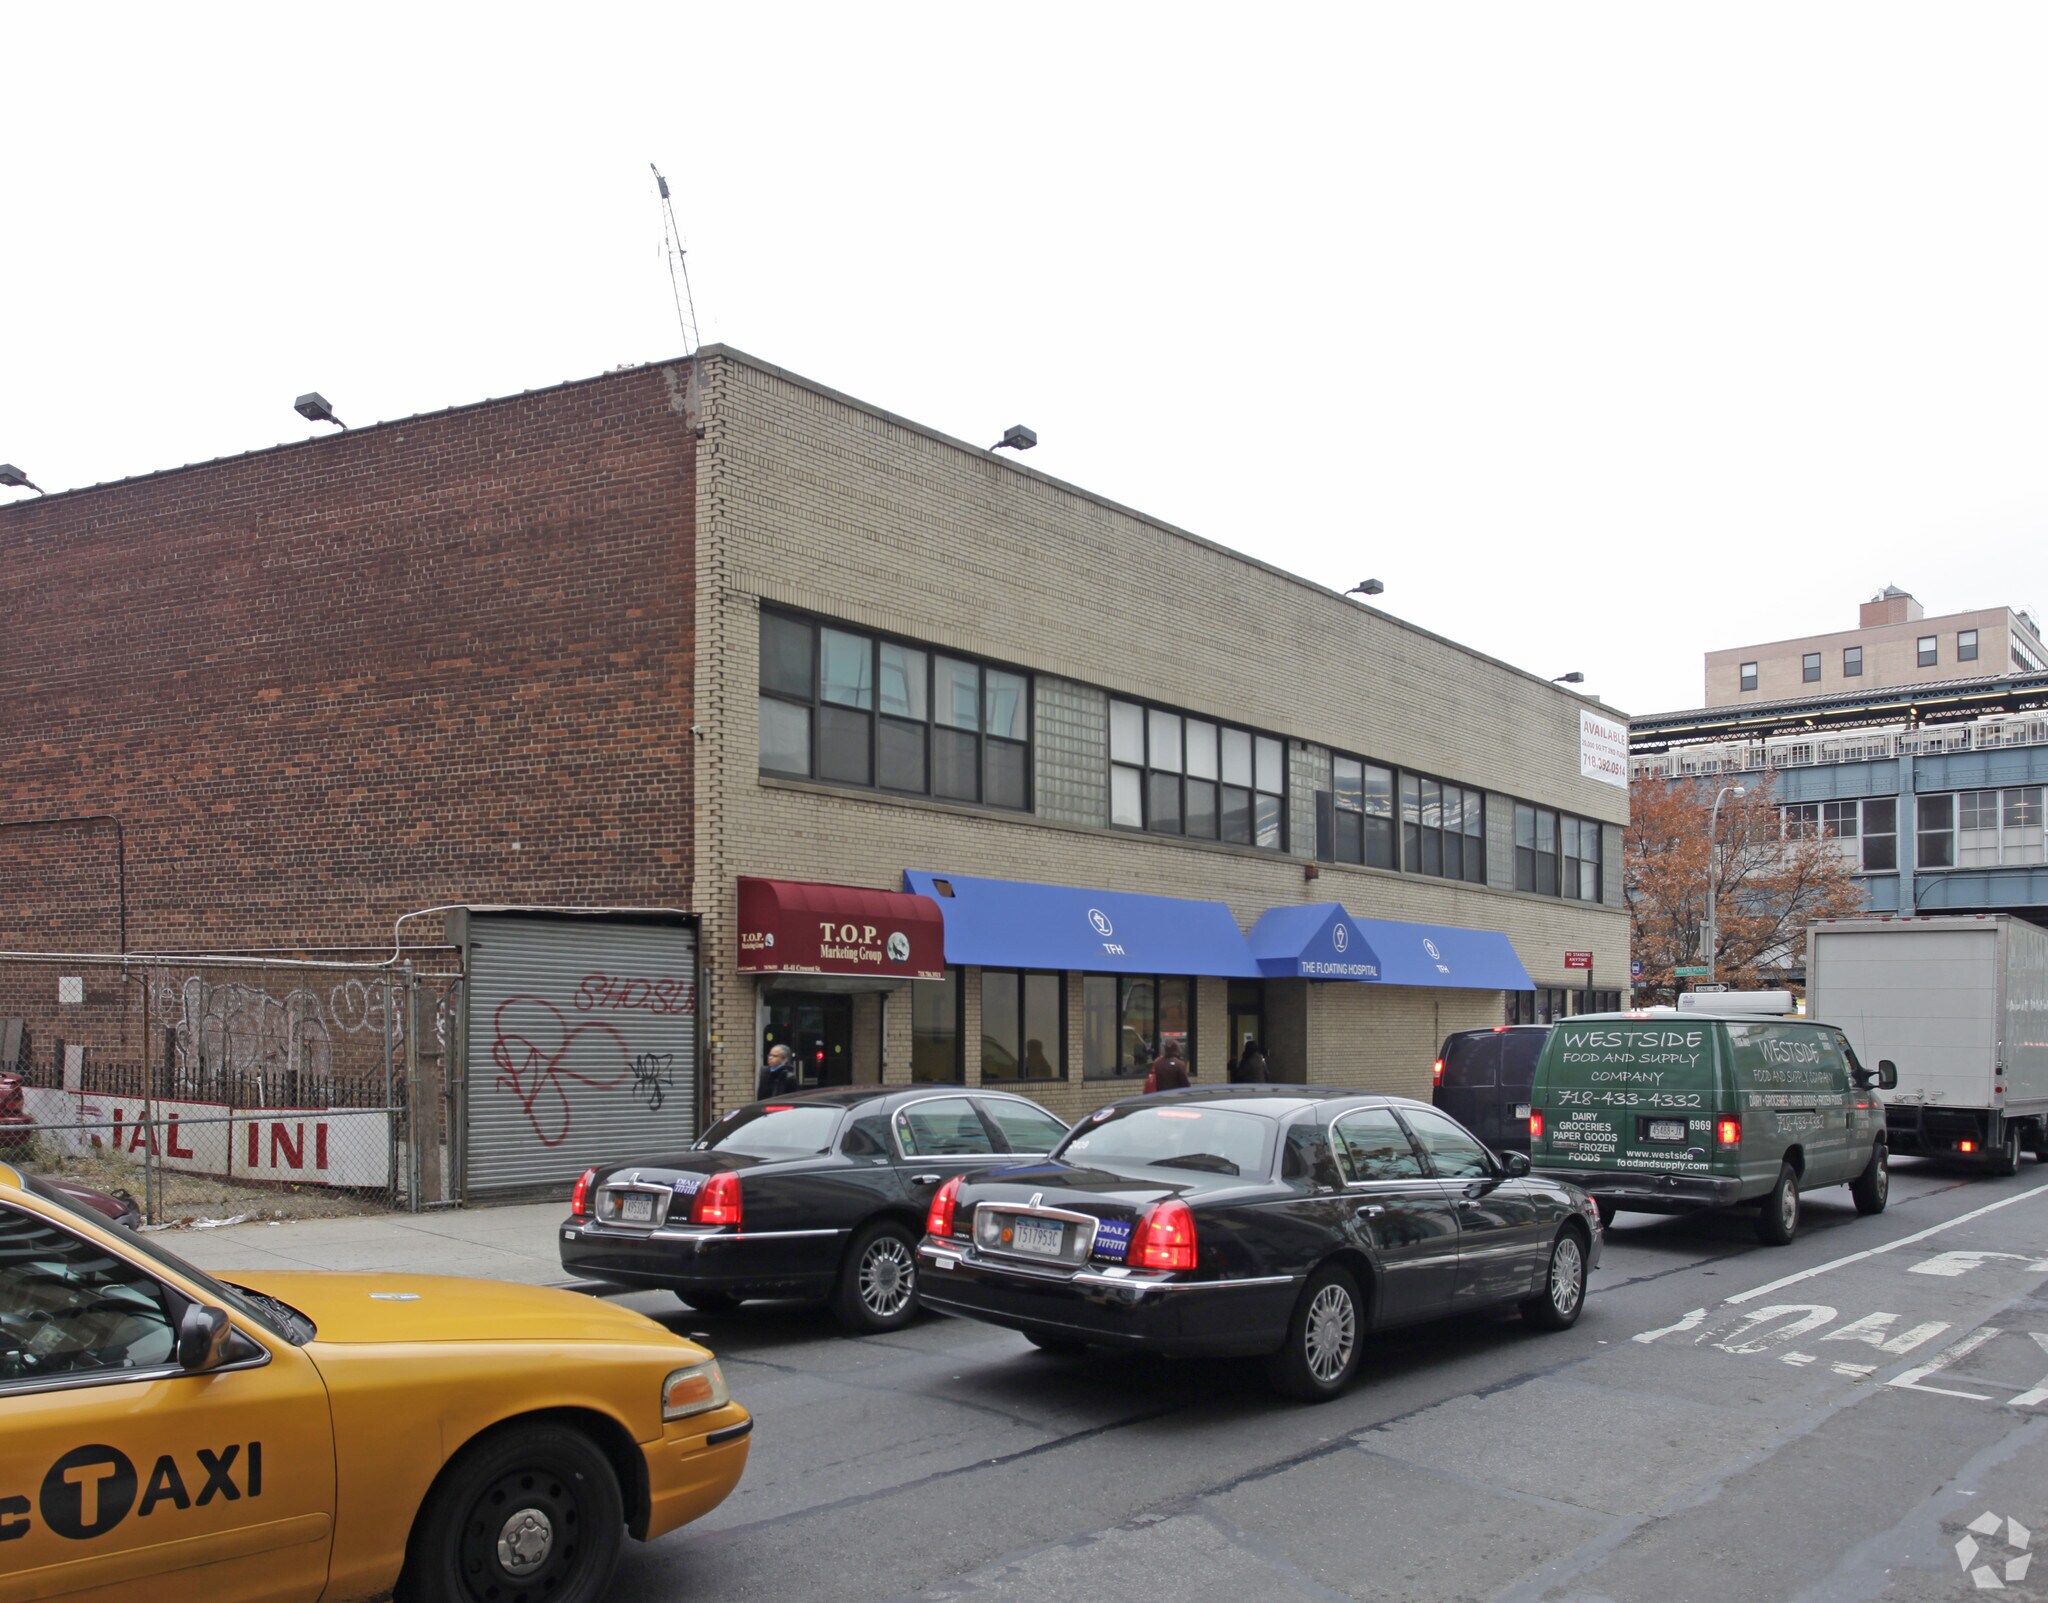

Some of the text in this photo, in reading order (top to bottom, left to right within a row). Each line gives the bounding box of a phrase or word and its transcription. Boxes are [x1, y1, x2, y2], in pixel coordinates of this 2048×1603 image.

[1583, 721, 1625, 746] AVAILABLE
[1583, 753, 1625, 777] 718.392.0514
[741, 932, 765, 943] T.O.P.
[820, 922, 882, 945] T.O.P.
[820, 944, 882, 965] Marketing Group
[1102, 943, 1125, 955] TFH
[1301, 961, 1378, 977] THE FLOATING HOSPITAL
[1564, 1031, 1703, 1048] WESTSIDE
[1758, 1039, 1820, 1064] WESTSIDE
[1563, 1052, 1700, 1068] FOOD AND SUPPLY
[1591, 1071, 1664, 1086] COMPANY
[1753, 1069, 1772, 1082] FOOD
[1558, 1090, 1702, 1108] 718-433-4332
[1572, 1112, 1597, 1121] DAIRY
[1559, 1121, 1611, 1132] GROCERIES
[1689, 1120, 1711, 1131] 6969
[1553, 1131, 1618, 1142] PAPER GOODS
[1579, 1143, 1615, 1153] FROZEN
[1626, 1150, 1694, 1161] www.westside
[1568, 1152, 1600, 1162] FOODS
[1617, 1158, 1709, 1170] foodandsupply.com
[1017, 1226, 1058, 1248] T517953C
[42, 1441, 262, 1538] TAXI
